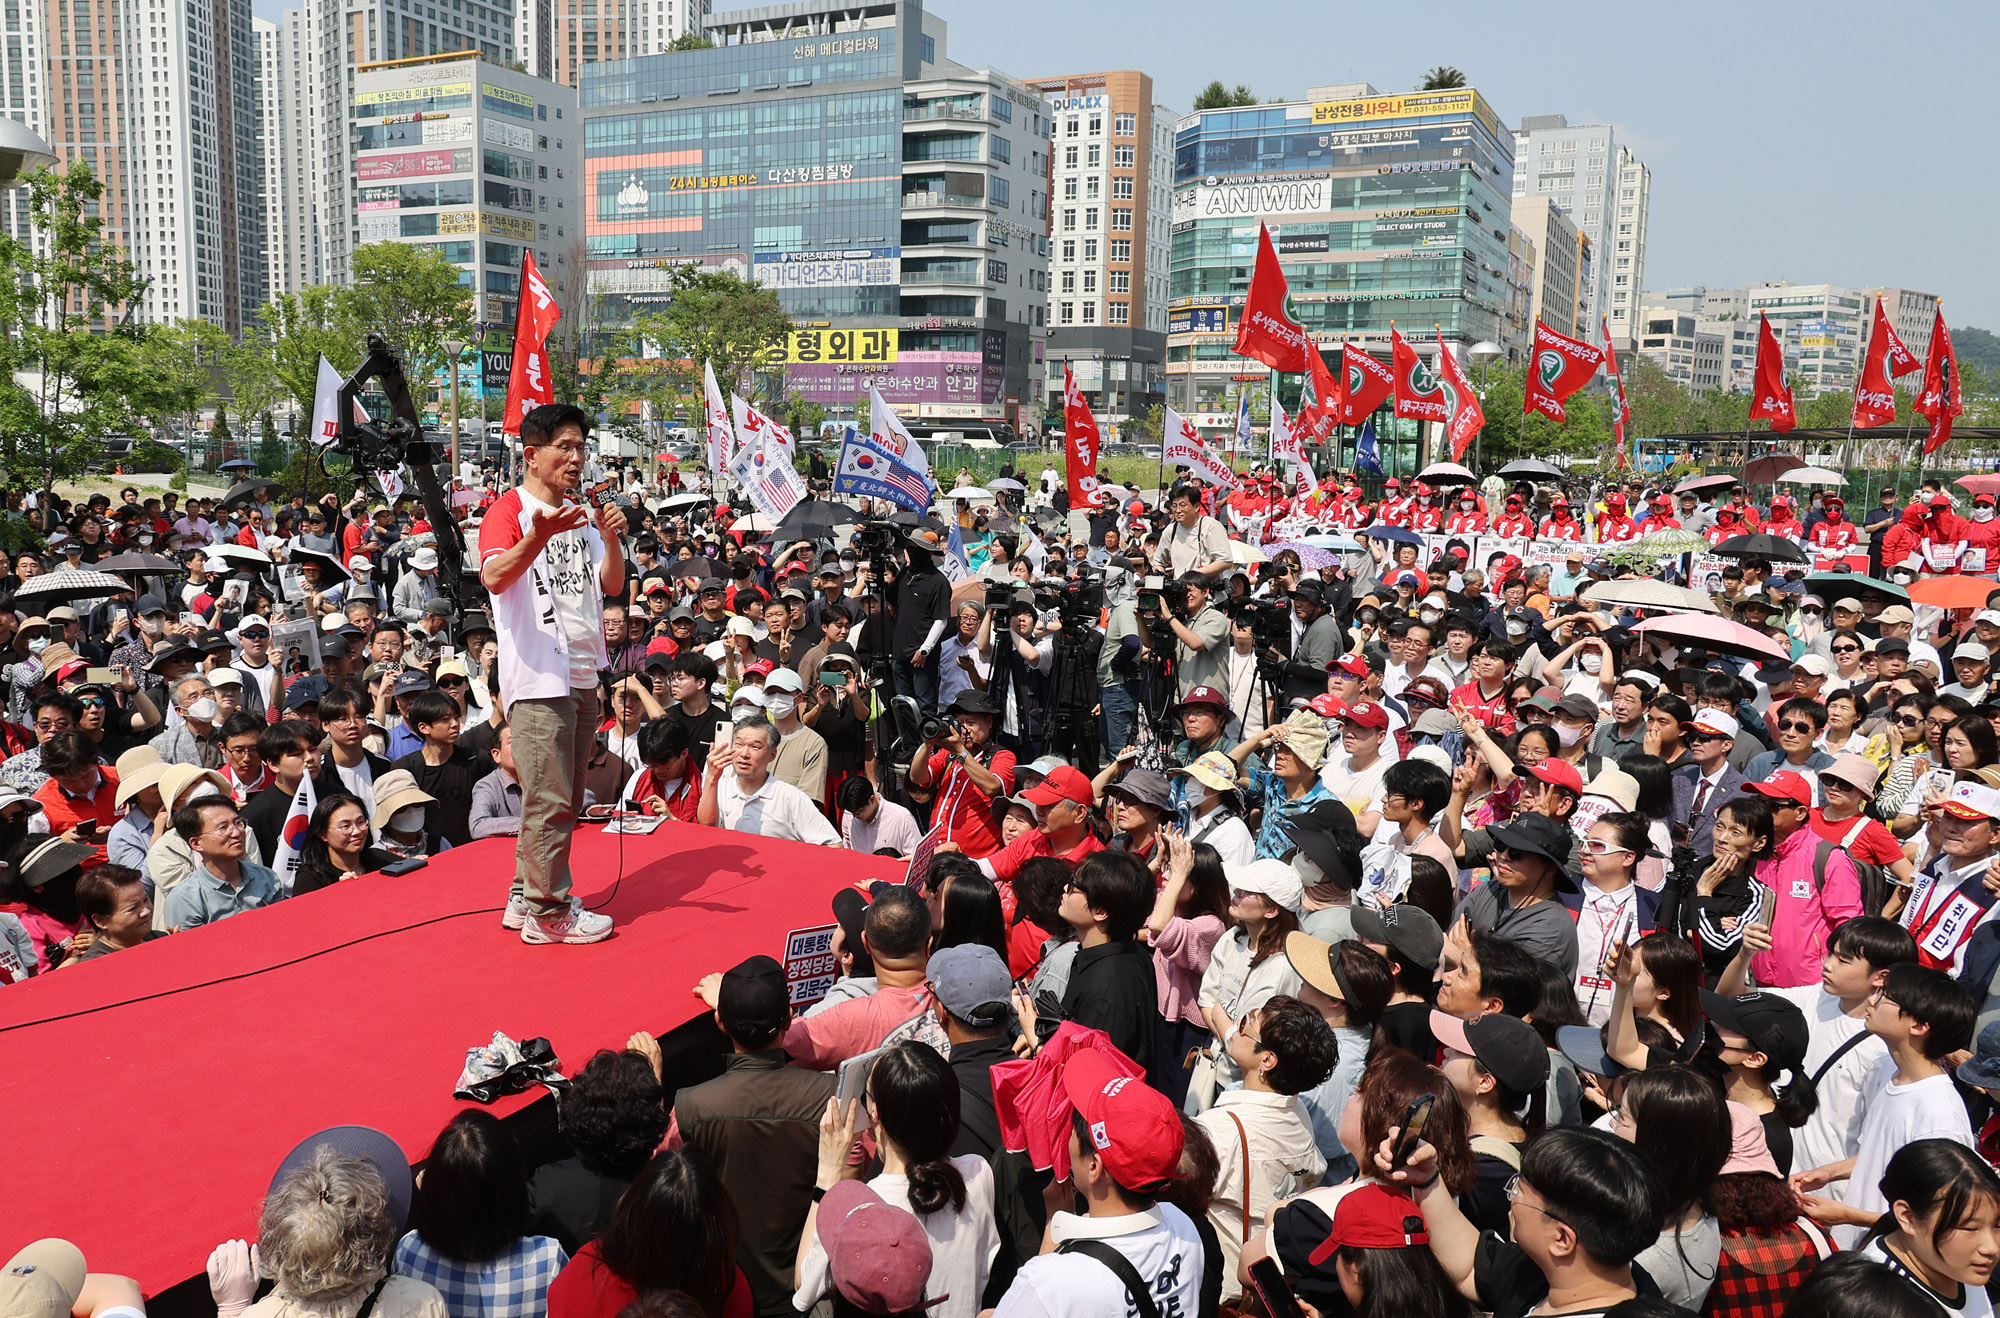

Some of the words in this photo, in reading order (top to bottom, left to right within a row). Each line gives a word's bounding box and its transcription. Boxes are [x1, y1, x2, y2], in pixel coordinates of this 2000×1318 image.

[793, 43, 816, 60] 신해
[820, 35, 880, 57] 메디컬타워
[1053, 96, 1102, 111] DUPLEX
[1413, 102, 1470, 113] 031-553-1121
[1331, 133, 1360, 146] 호텔식
[1361, 133, 1380, 144] 피부
[1451, 127, 1469, 137] 24시
[1451, 147, 1464, 157] 8F
[669, 175, 698, 191] 24시
[700, 174, 759, 189] 힐링플레이스
[768, 163, 855, 185] 다산킹찜질방
[1222, 176, 1256, 186] ANIWIN
[1206, 182, 1322, 215] ANIWIN
[617, 206, 649, 215] DASANKING
[441, 214, 455, 225] 관절
[463, 212, 477, 223] 척추
[481, 213, 493, 224] 관절
[494, 215, 508, 227] 척추
[508, 217, 520, 229] 내과
[521, 219, 533, 232] 검진
[1376, 224, 1399, 232] SELECT
[1399, 223, 1414, 231] GYM
[1414, 222, 1424, 230] PT
[1424, 221, 1447, 230] STUDIO
[788, 251, 843, 262] 가디언즈치과의원
[772, 262, 865, 286] 가디언즈치과
[988, 260, 1007, 282] 치과
[484, 353, 512, 372] YOU
[846, 364, 889, 373] 은하수안과의원
[955, 364, 978, 373] 은하수
[875, 375, 938, 392] 은하수안과
[945, 376, 979, 393] 안과
[586, 488, 600, 507] 2
[597, 488, 619, 505] 김문수
[1388, 506, 1400, 521] 2
[1422, 513, 1434, 528] 2
[1464, 519, 1477, 534] 2
[1511, 522, 1525, 536] 2
[1563, 525, 1575, 540] 2
[1616, 523, 1631, 539] 2
[1837, 530, 1850, 546] 2
[1537, 546, 1549, 554] 저는
[1585, 546, 1598, 556] 저는
[1930, 903, 1969, 952] 취타단
[787, 954, 837, 980] 정정당당
[796, 978, 833, 1001] 김문수
[921, 1030, 935, 1041] ON
